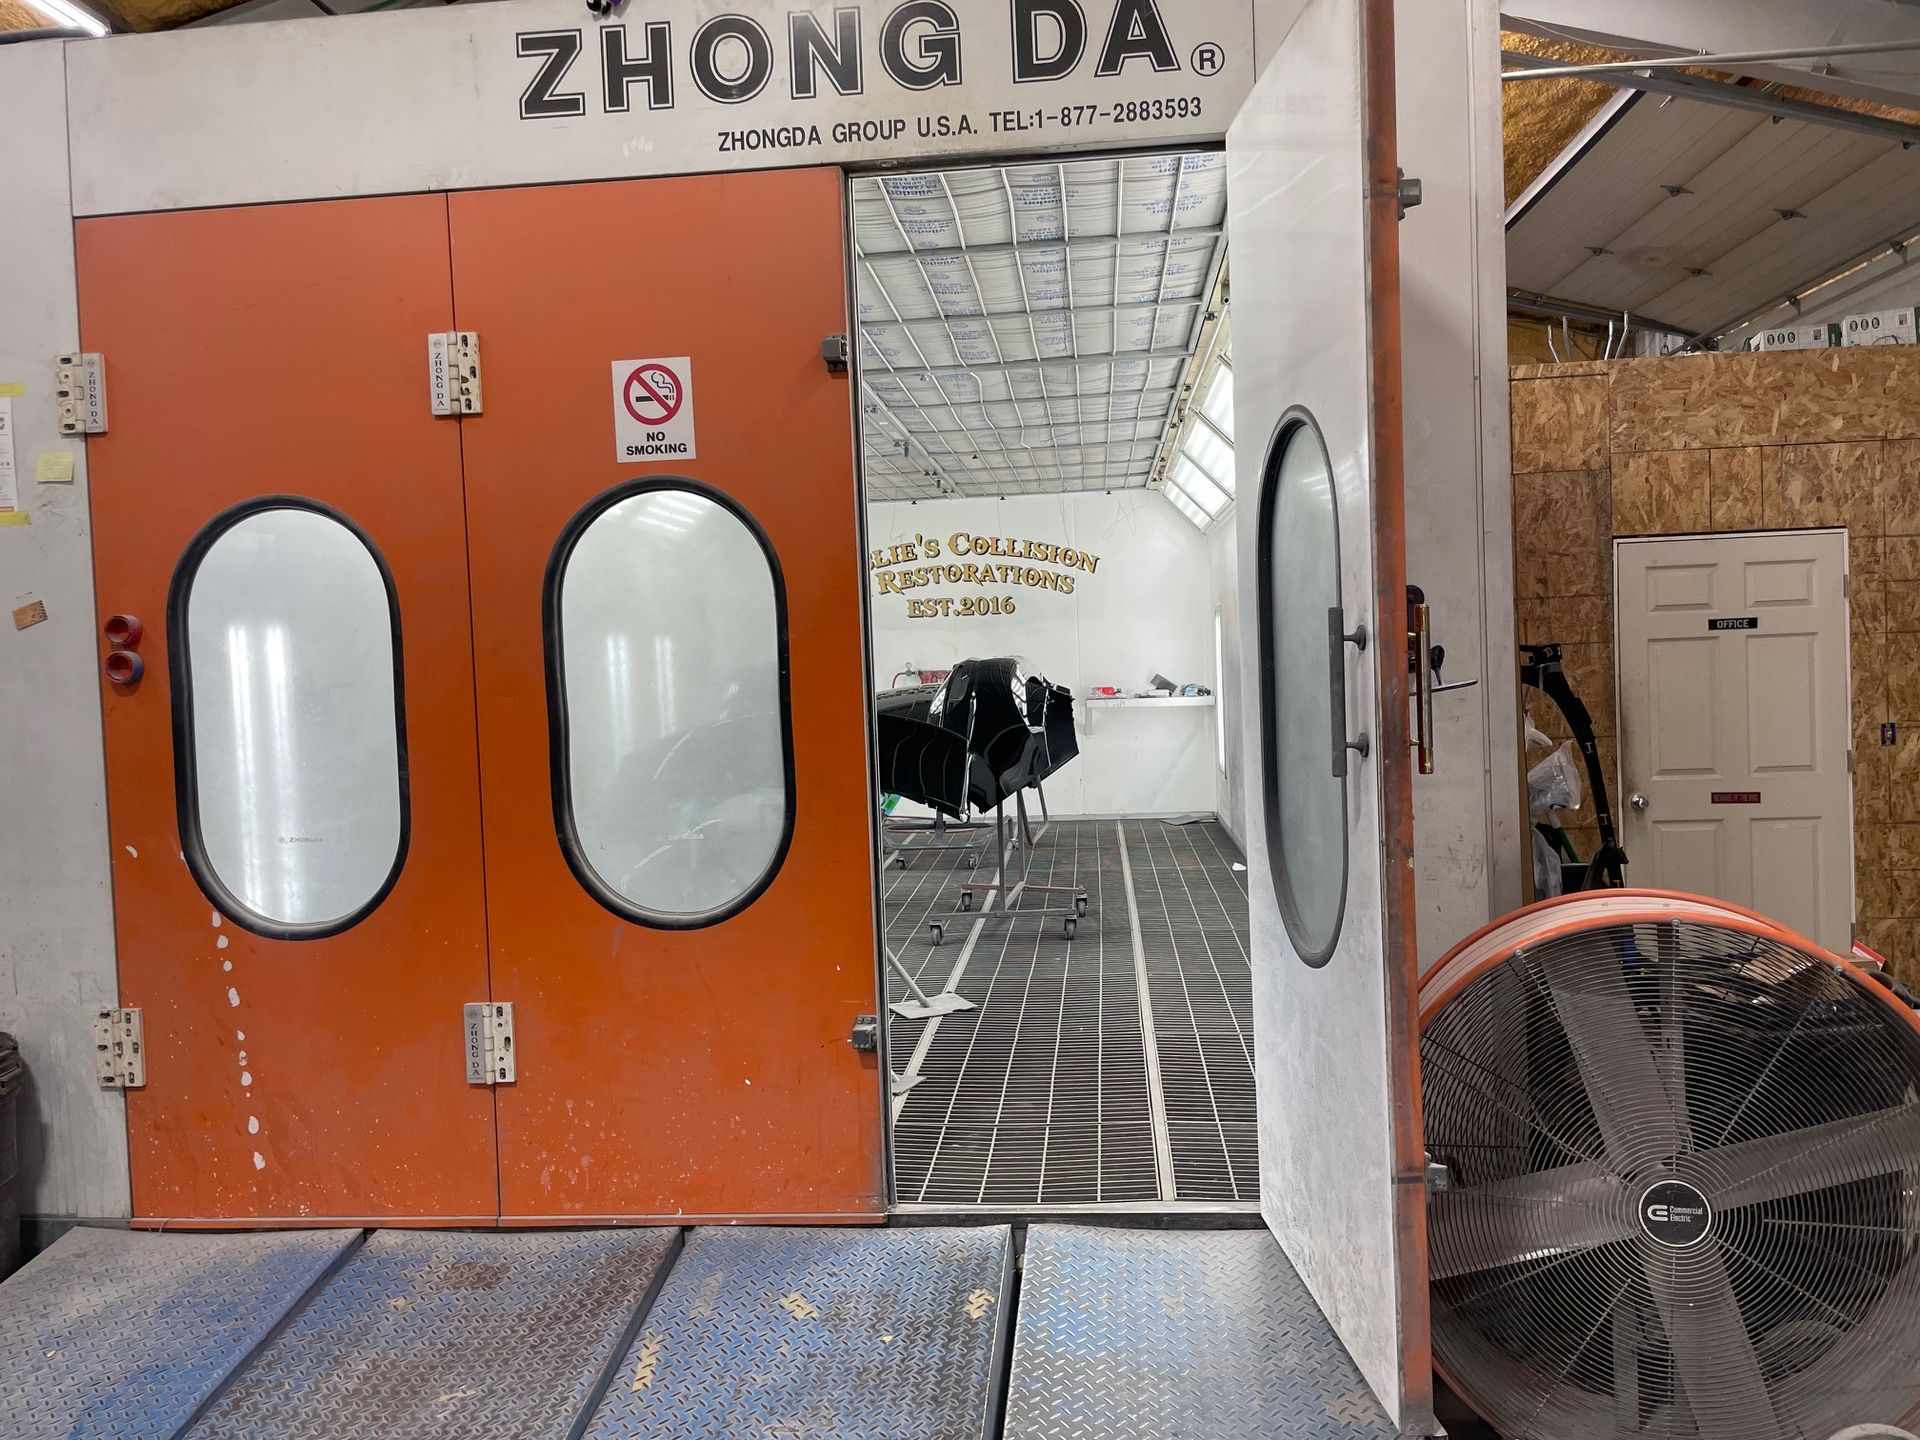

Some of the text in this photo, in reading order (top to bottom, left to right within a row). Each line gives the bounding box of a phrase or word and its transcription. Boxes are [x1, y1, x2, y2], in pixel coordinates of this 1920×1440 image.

[515, 0, 963, 121] ZHONG
[1008, 0, 1182, 85] DA
[717, 96, 1203, 153] ZHONGDA GROUP U.S.A. TEL:1-877-2883593
[434, 352, 444, 389] ZHONG
[88, 371, 97, 407] ZHONG
[436, 392, 445, 407] DA
[90, 410, 99, 425] DA
[646, 431, 666, 442] NO
[626, 442, 688, 456] SMOKING
[947, 532, 1100, 574] COLLISION
[875, 563, 1075, 596] RESTORATIONS
[906, 595, 1016, 618] EST.2016
[1716, 619, 1750, 629] OFFICE
[470, 1023, 479, 1058] ZHONG
[472, 1061, 480, 1076] DA
[1669, 1205, 1703, 1215] Commercial
[1670, 1213, 1691, 1222] Electric
